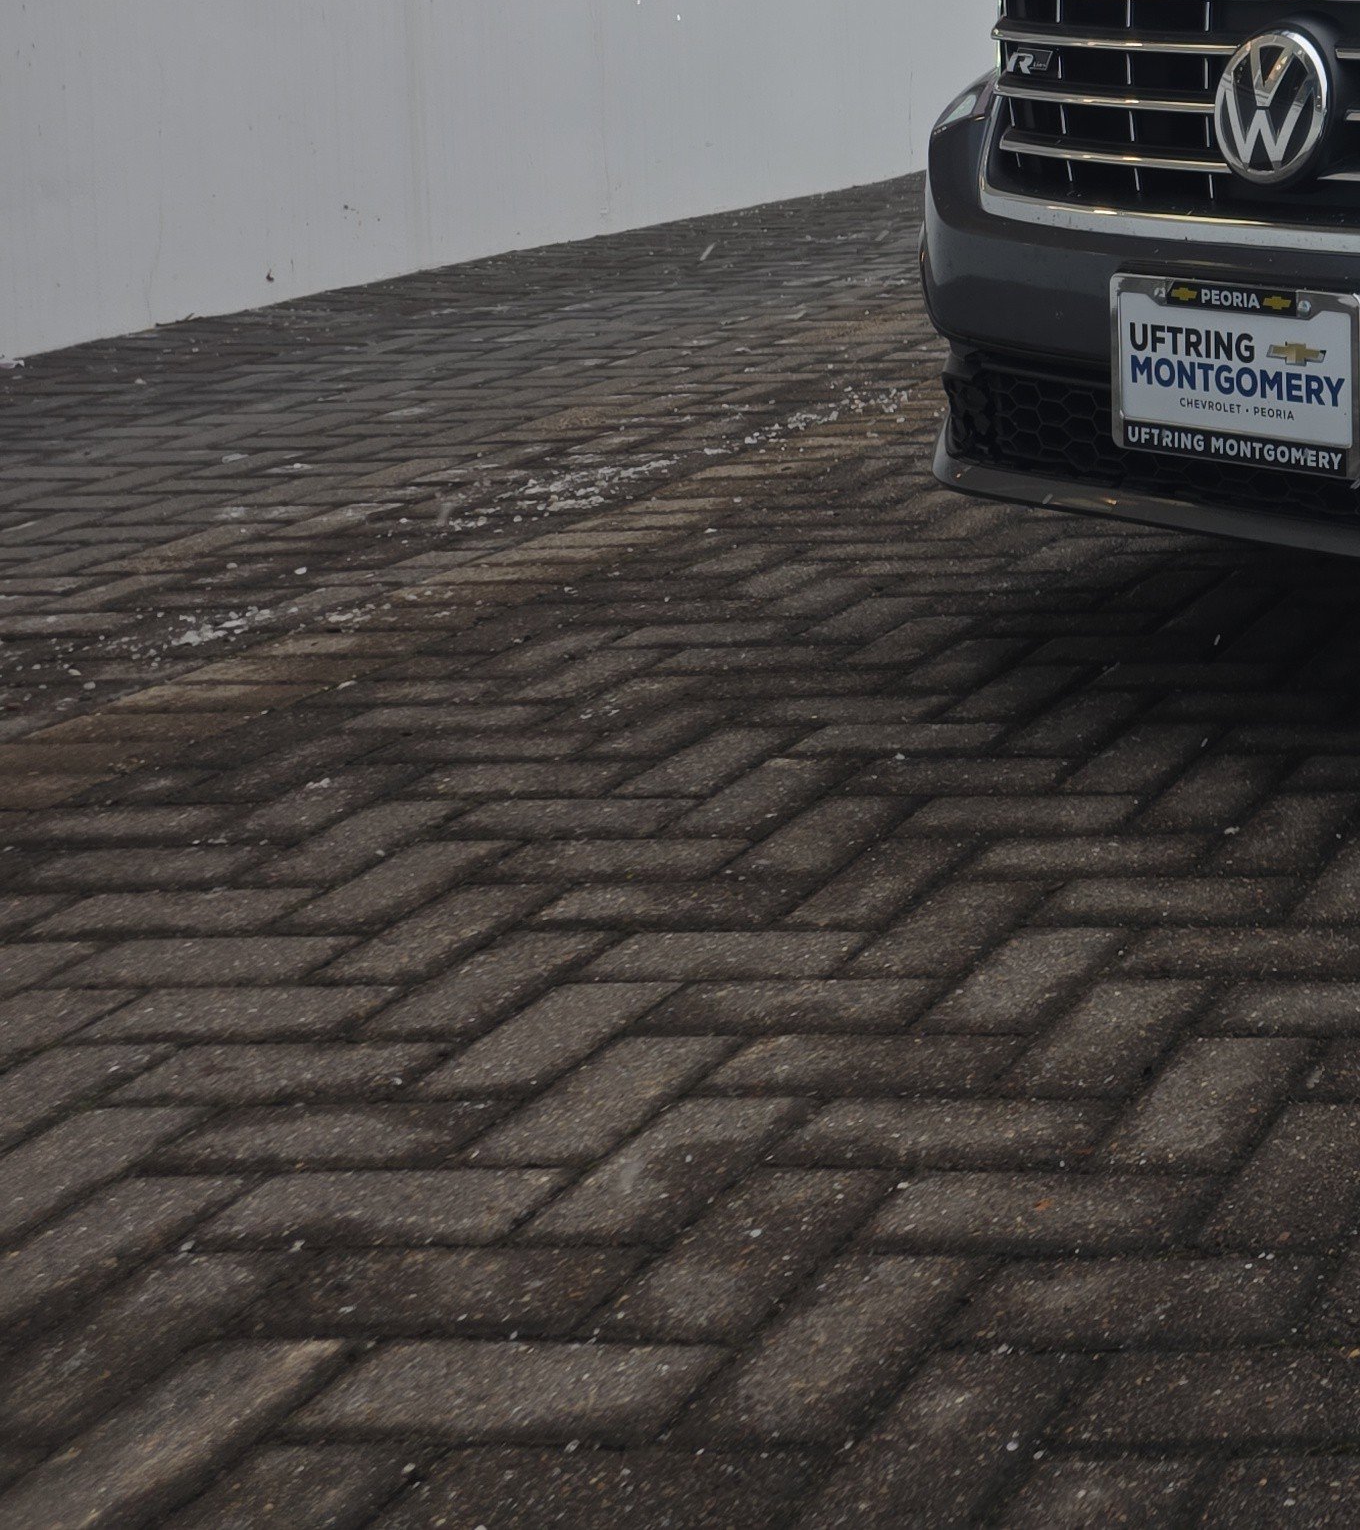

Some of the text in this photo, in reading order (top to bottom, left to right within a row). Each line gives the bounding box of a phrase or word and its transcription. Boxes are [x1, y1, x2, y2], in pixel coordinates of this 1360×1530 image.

[1201, 289, 1260, 309] PEORIA
[1130, 322, 1255, 364] UFTRING
[1130, 355, 1345, 407] MONTGOMERY
[1179, 397, 1295, 421] CHEVROLET PEORIA
[1127, 425, 1342, 470] UFTRING MONTGOMERY
